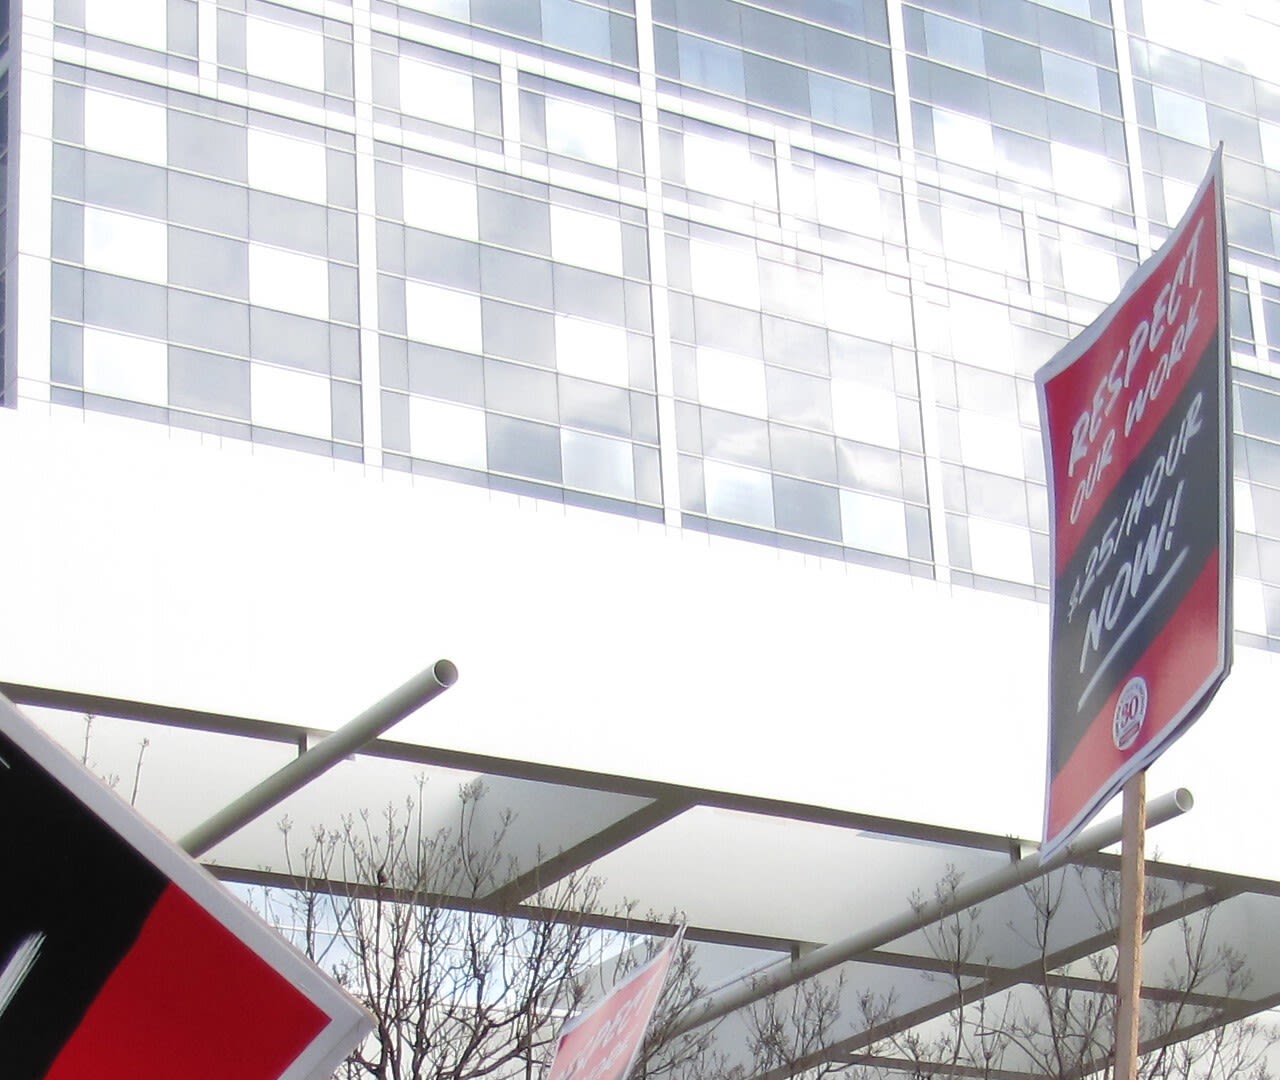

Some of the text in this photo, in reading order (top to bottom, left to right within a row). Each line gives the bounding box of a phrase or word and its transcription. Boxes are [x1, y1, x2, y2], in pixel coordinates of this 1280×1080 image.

[1068, 217, 1204, 477] RESPECT
[1070, 289, 1202, 525] OUR WORK
[1068, 391, 1203, 623] $25/HOUR
[1080, 480, 1185, 674] NOW!
